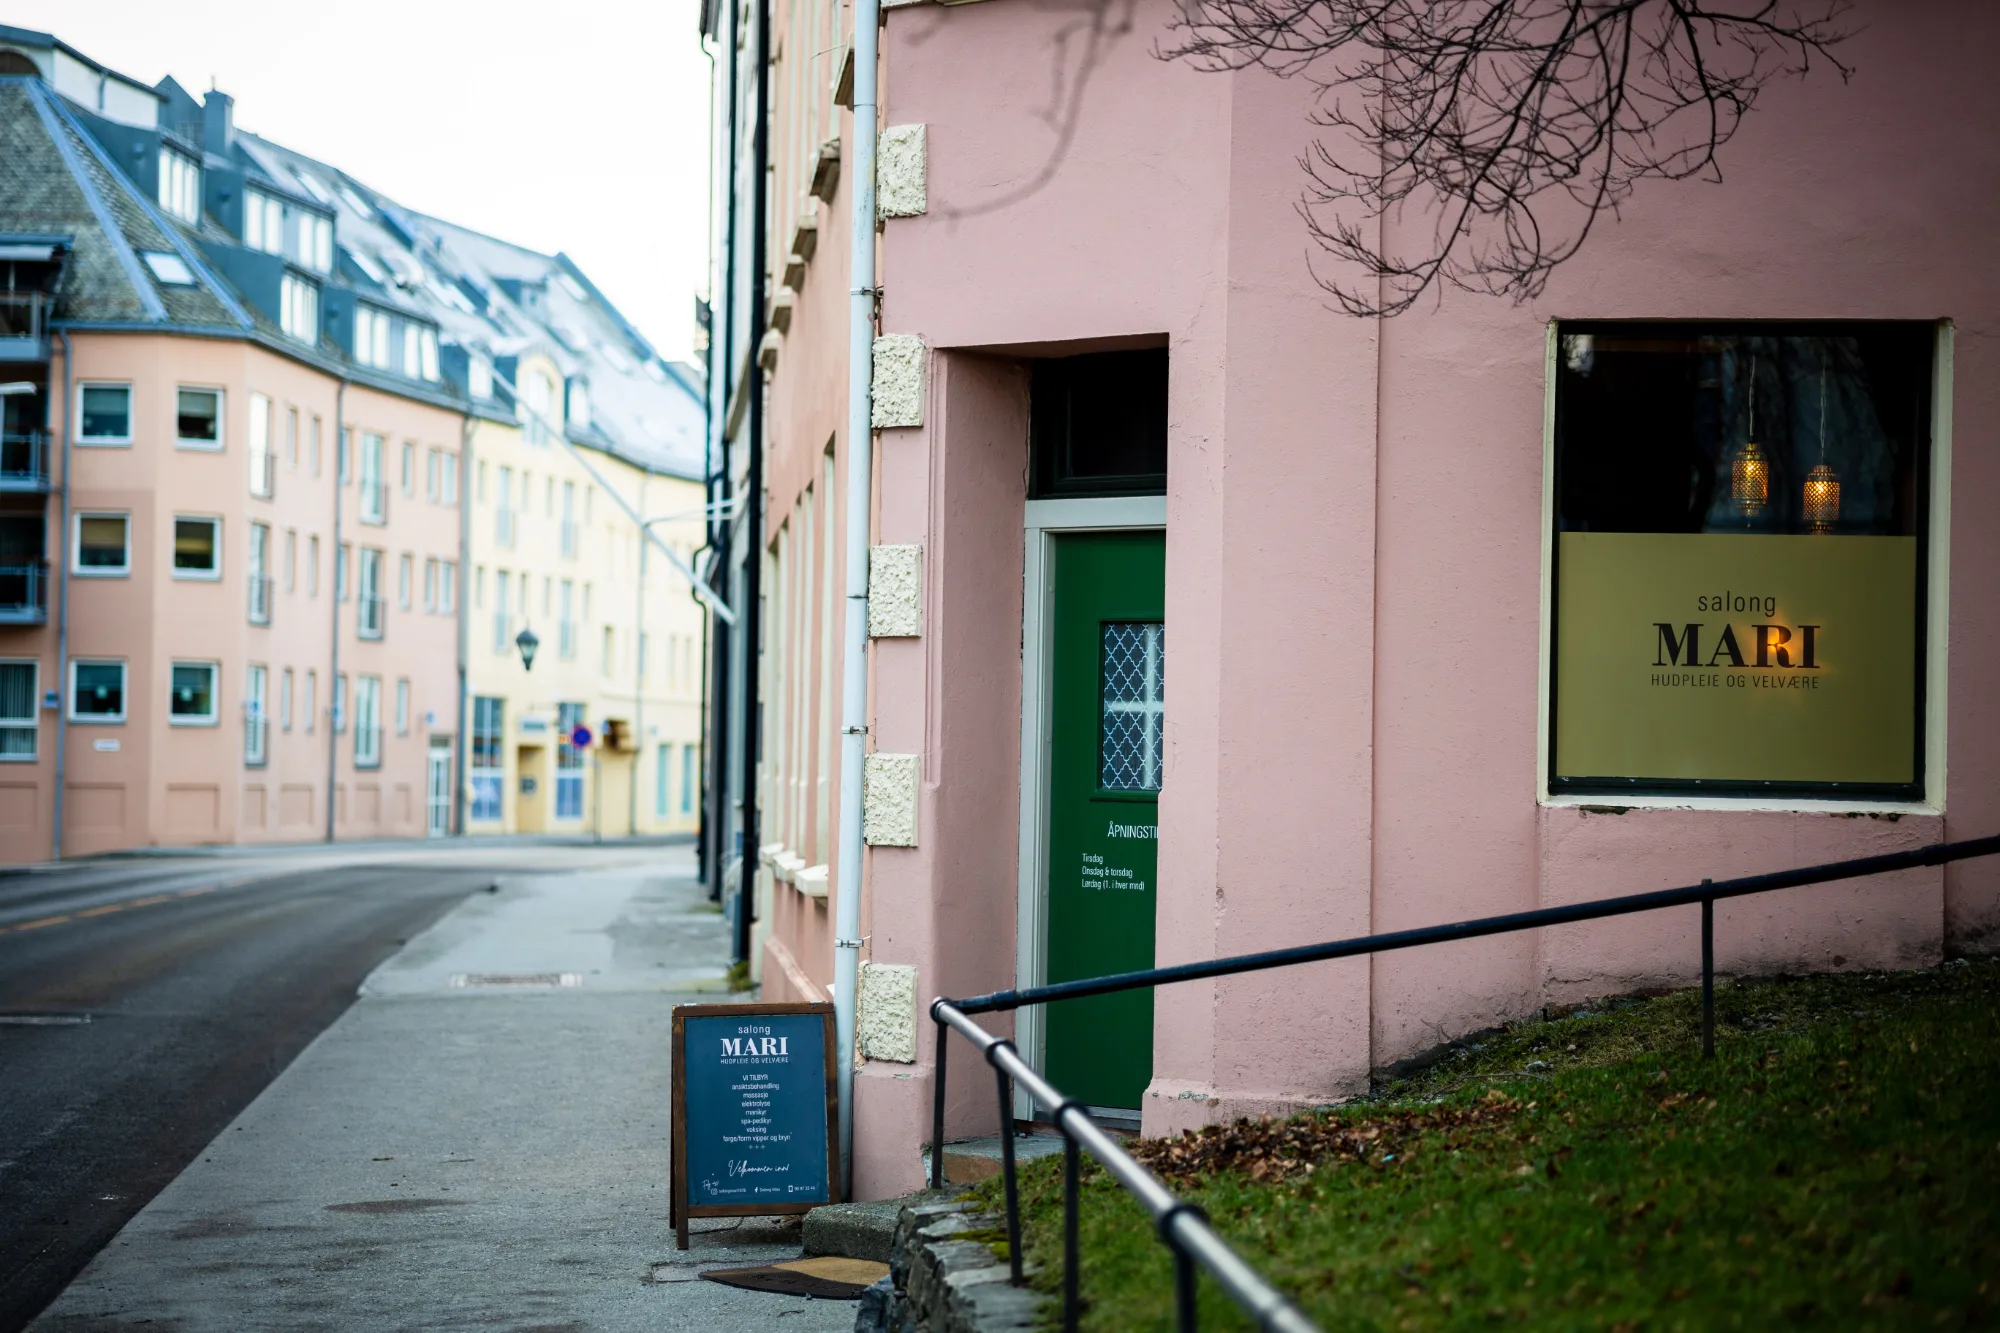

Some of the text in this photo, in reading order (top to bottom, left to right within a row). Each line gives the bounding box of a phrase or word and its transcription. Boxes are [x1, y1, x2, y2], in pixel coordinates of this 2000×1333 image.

[1698, 590, 1776, 618] salong
[1652, 623, 1820, 668] MARI
[1651, 674, 1819, 690] HUDPLEIE OG VELVÆRE
[1082, 853, 1103, 864] Tirsdag
[1082, 866, 1132, 878] Onsdag & torsdag
[1082, 879, 1101, 890] Lørdag
[1115, 880, 1128, 889] hver
[1129, 881, 1144, 891] mnd)
[738, 1025, 770, 1035] salong
[720, 1037, 788, 1056] MARI
